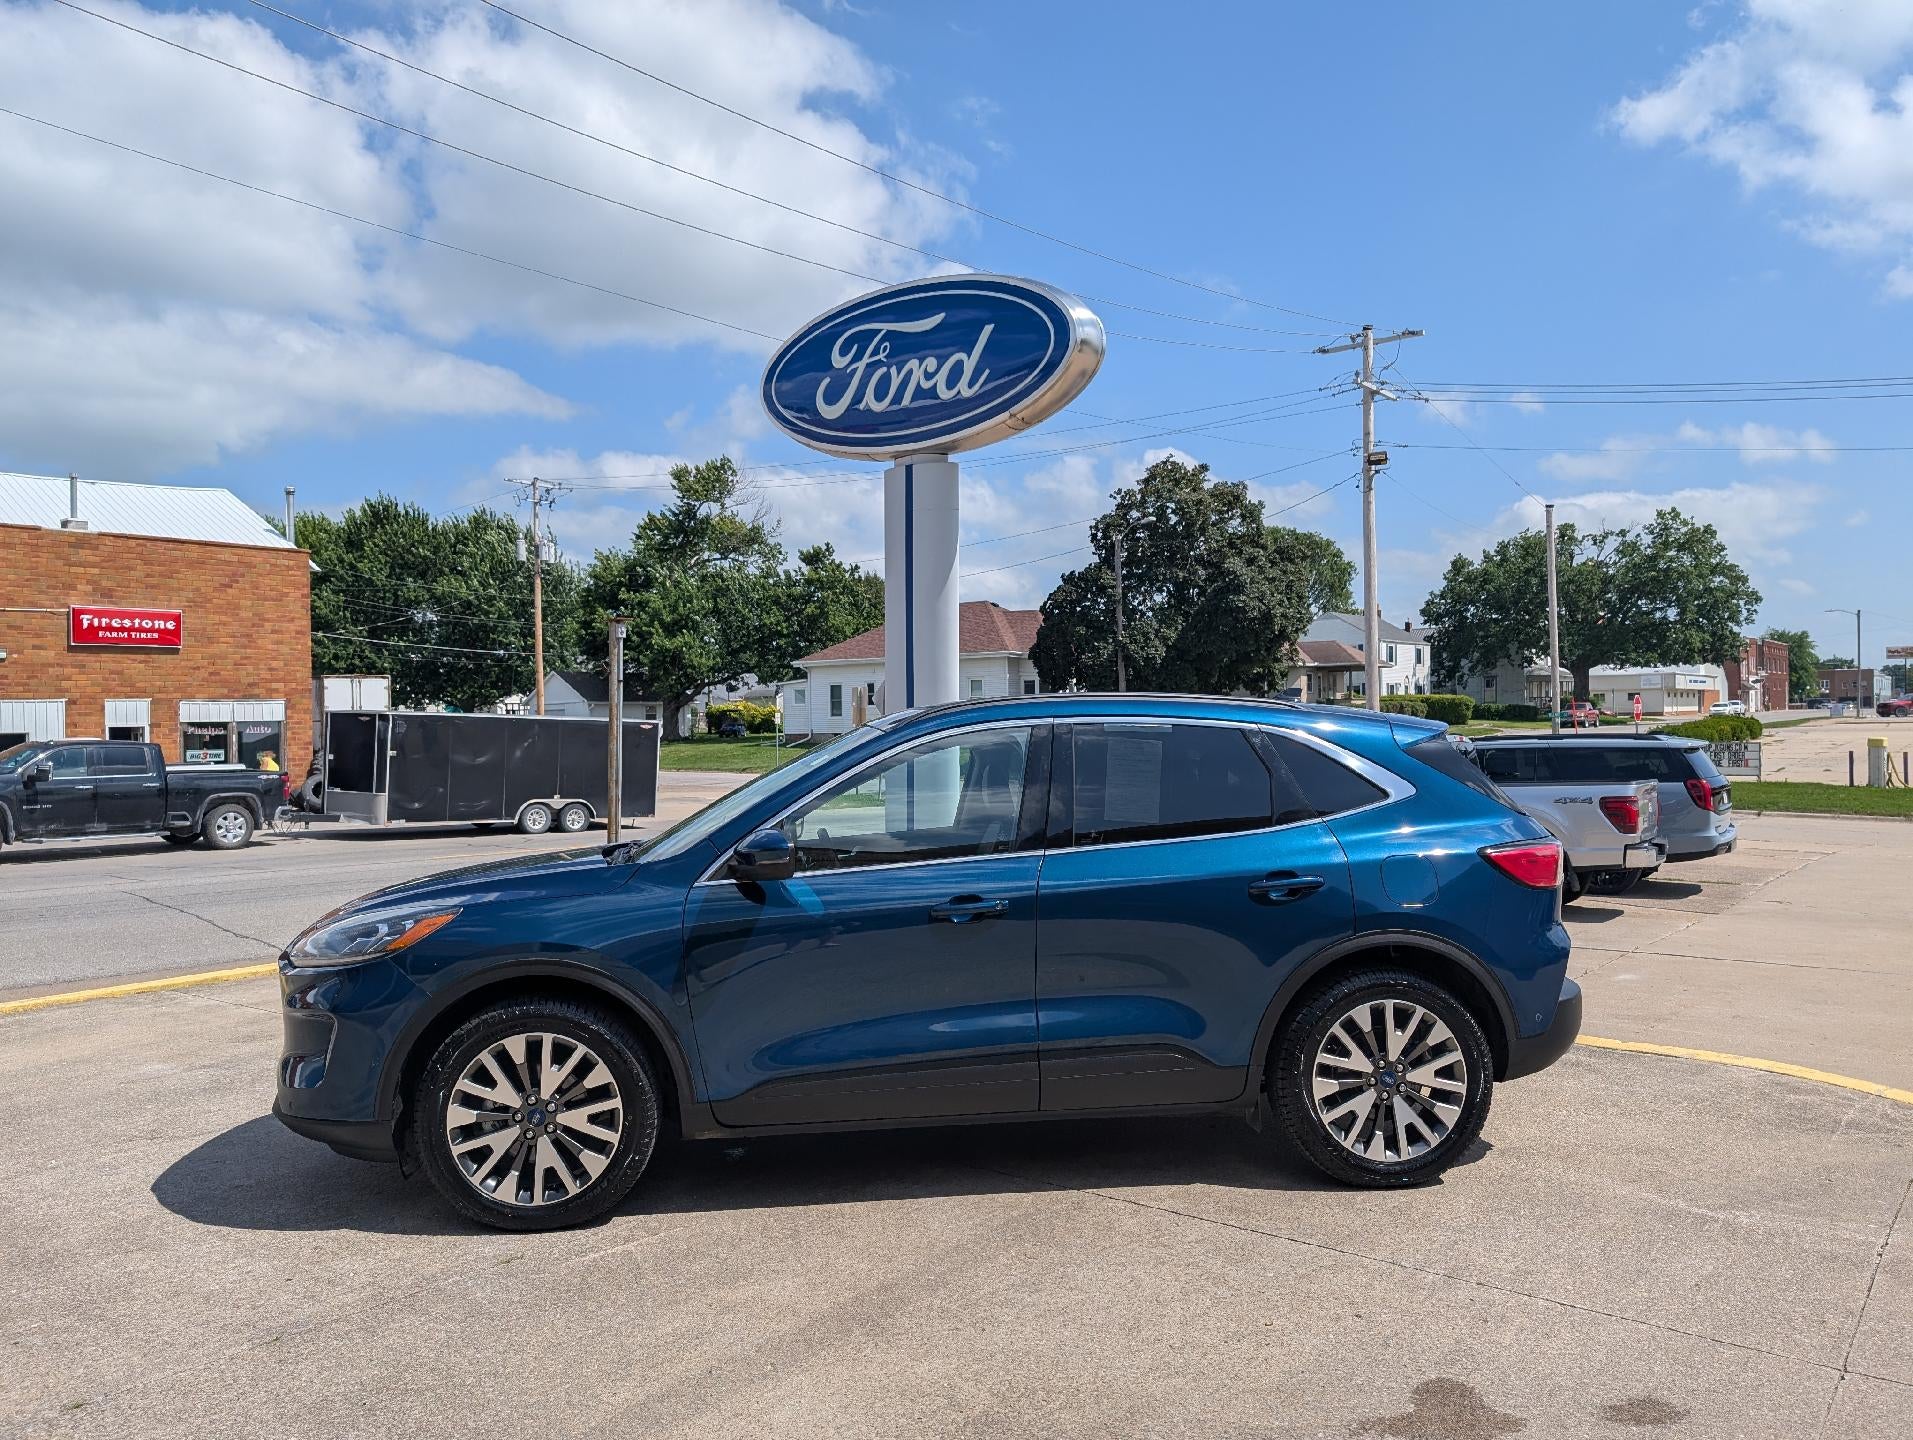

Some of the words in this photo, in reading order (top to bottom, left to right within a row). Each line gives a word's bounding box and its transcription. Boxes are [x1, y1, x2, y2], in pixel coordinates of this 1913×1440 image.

[816, 312, 995, 420] Ford
[80, 614, 177, 630] Firestone
[246, 724, 272, 733] Auto
[209, 752, 222, 760] TIRE
[1710, 751, 1725, 759] FIRST
[1728, 751, 1746, 759] ORDER
